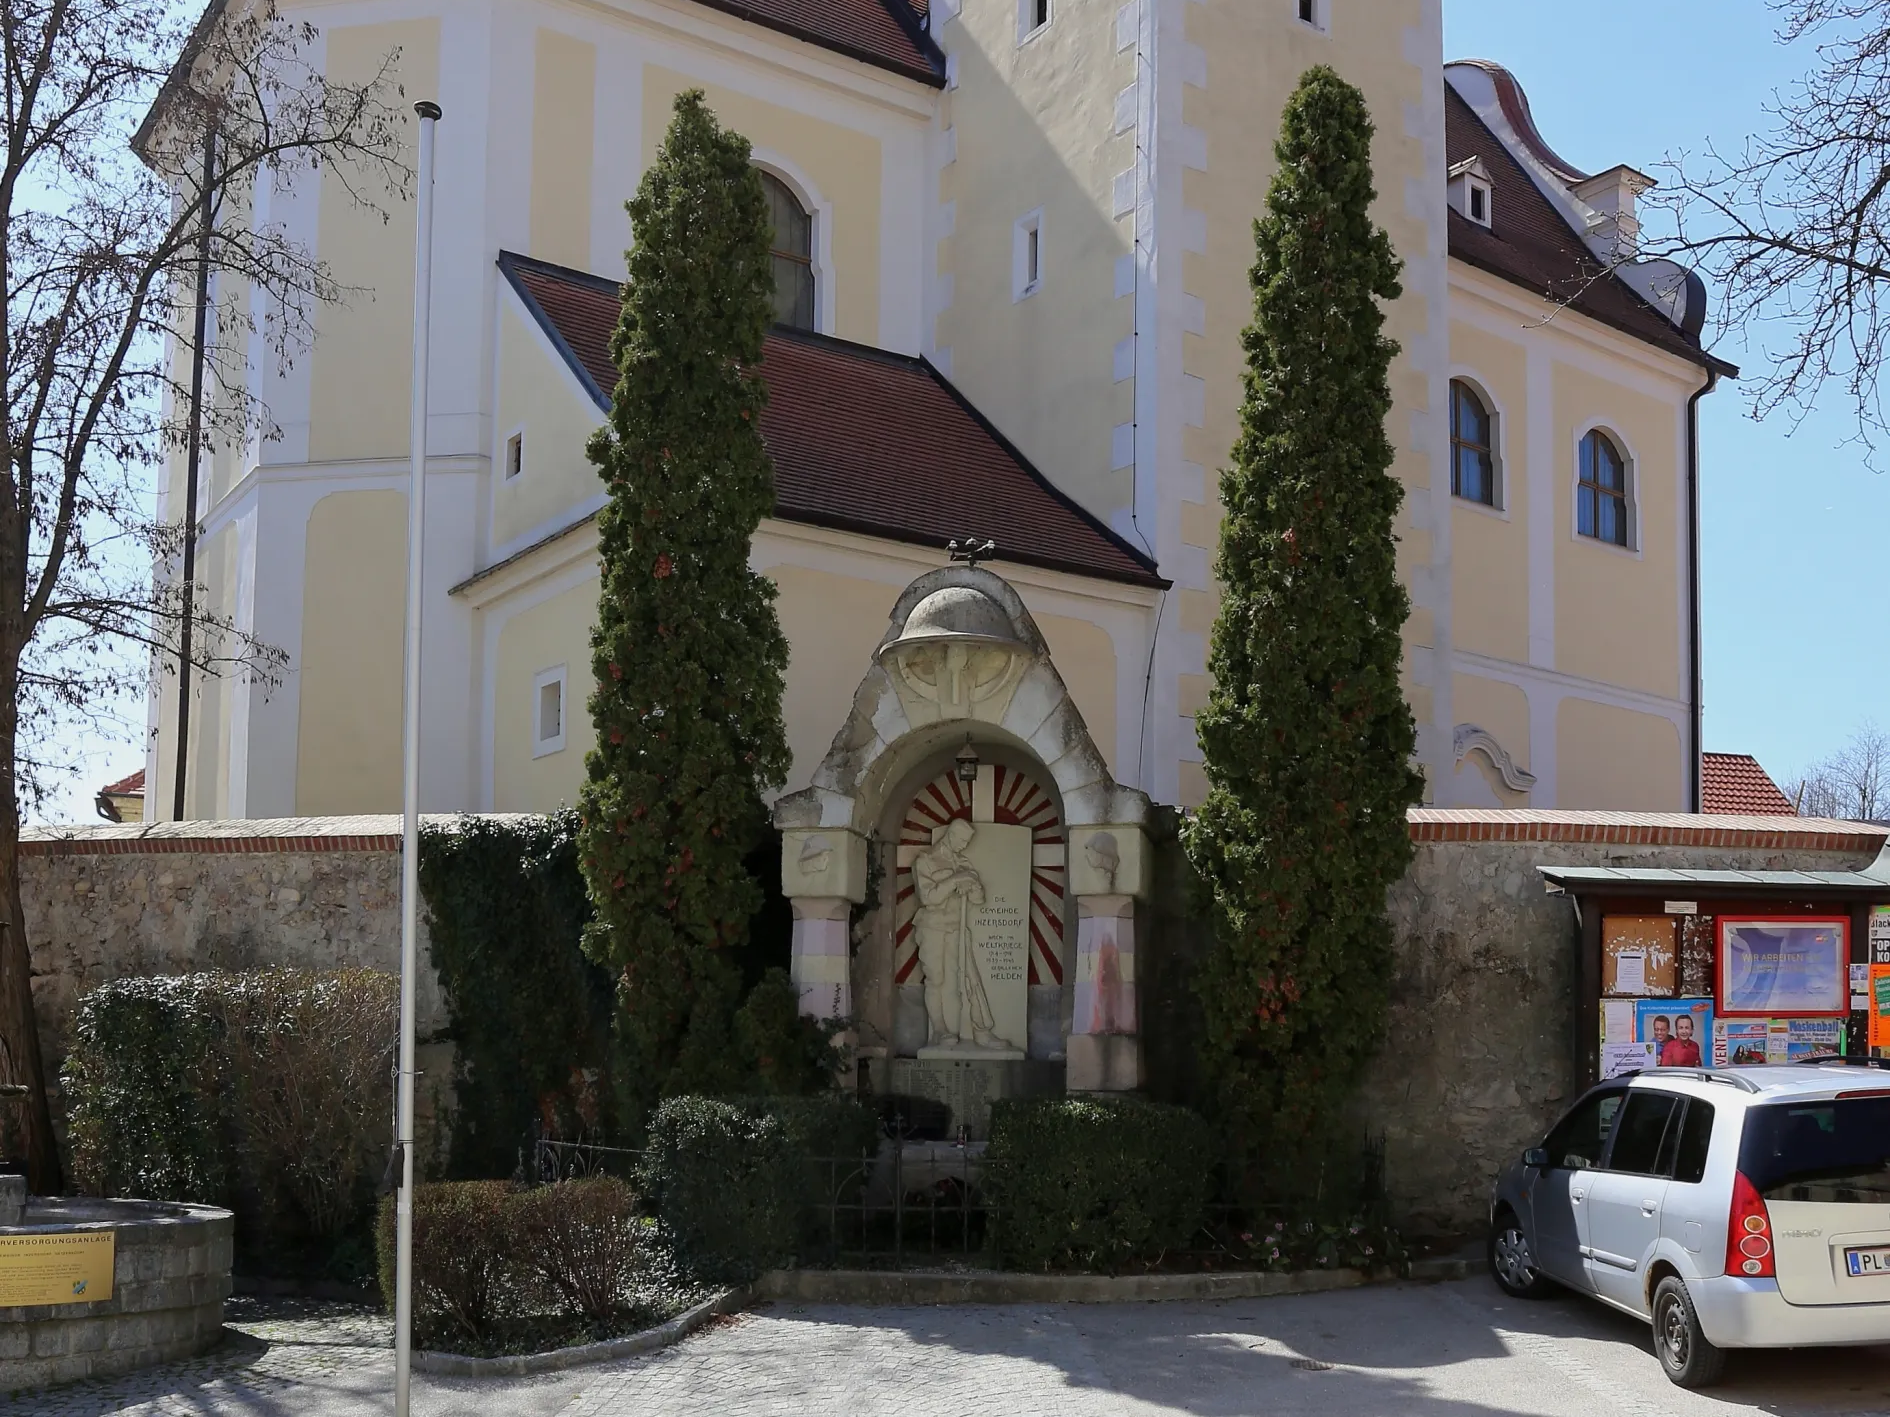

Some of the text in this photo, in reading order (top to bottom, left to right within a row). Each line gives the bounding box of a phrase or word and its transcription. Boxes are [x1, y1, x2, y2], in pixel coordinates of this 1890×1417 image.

[979, 907, 1019, 915] GEMEINDE
[974, 918, 1024, 928] INZERSDORF
[978, 942, 1023, 950] WELTKRIEGE
[1761, 953, 1804, 962] ARBEITEN
[1789, 1021, 1839, 1033] Maskenball
[1862, 1254, 1883, 1271] PL
